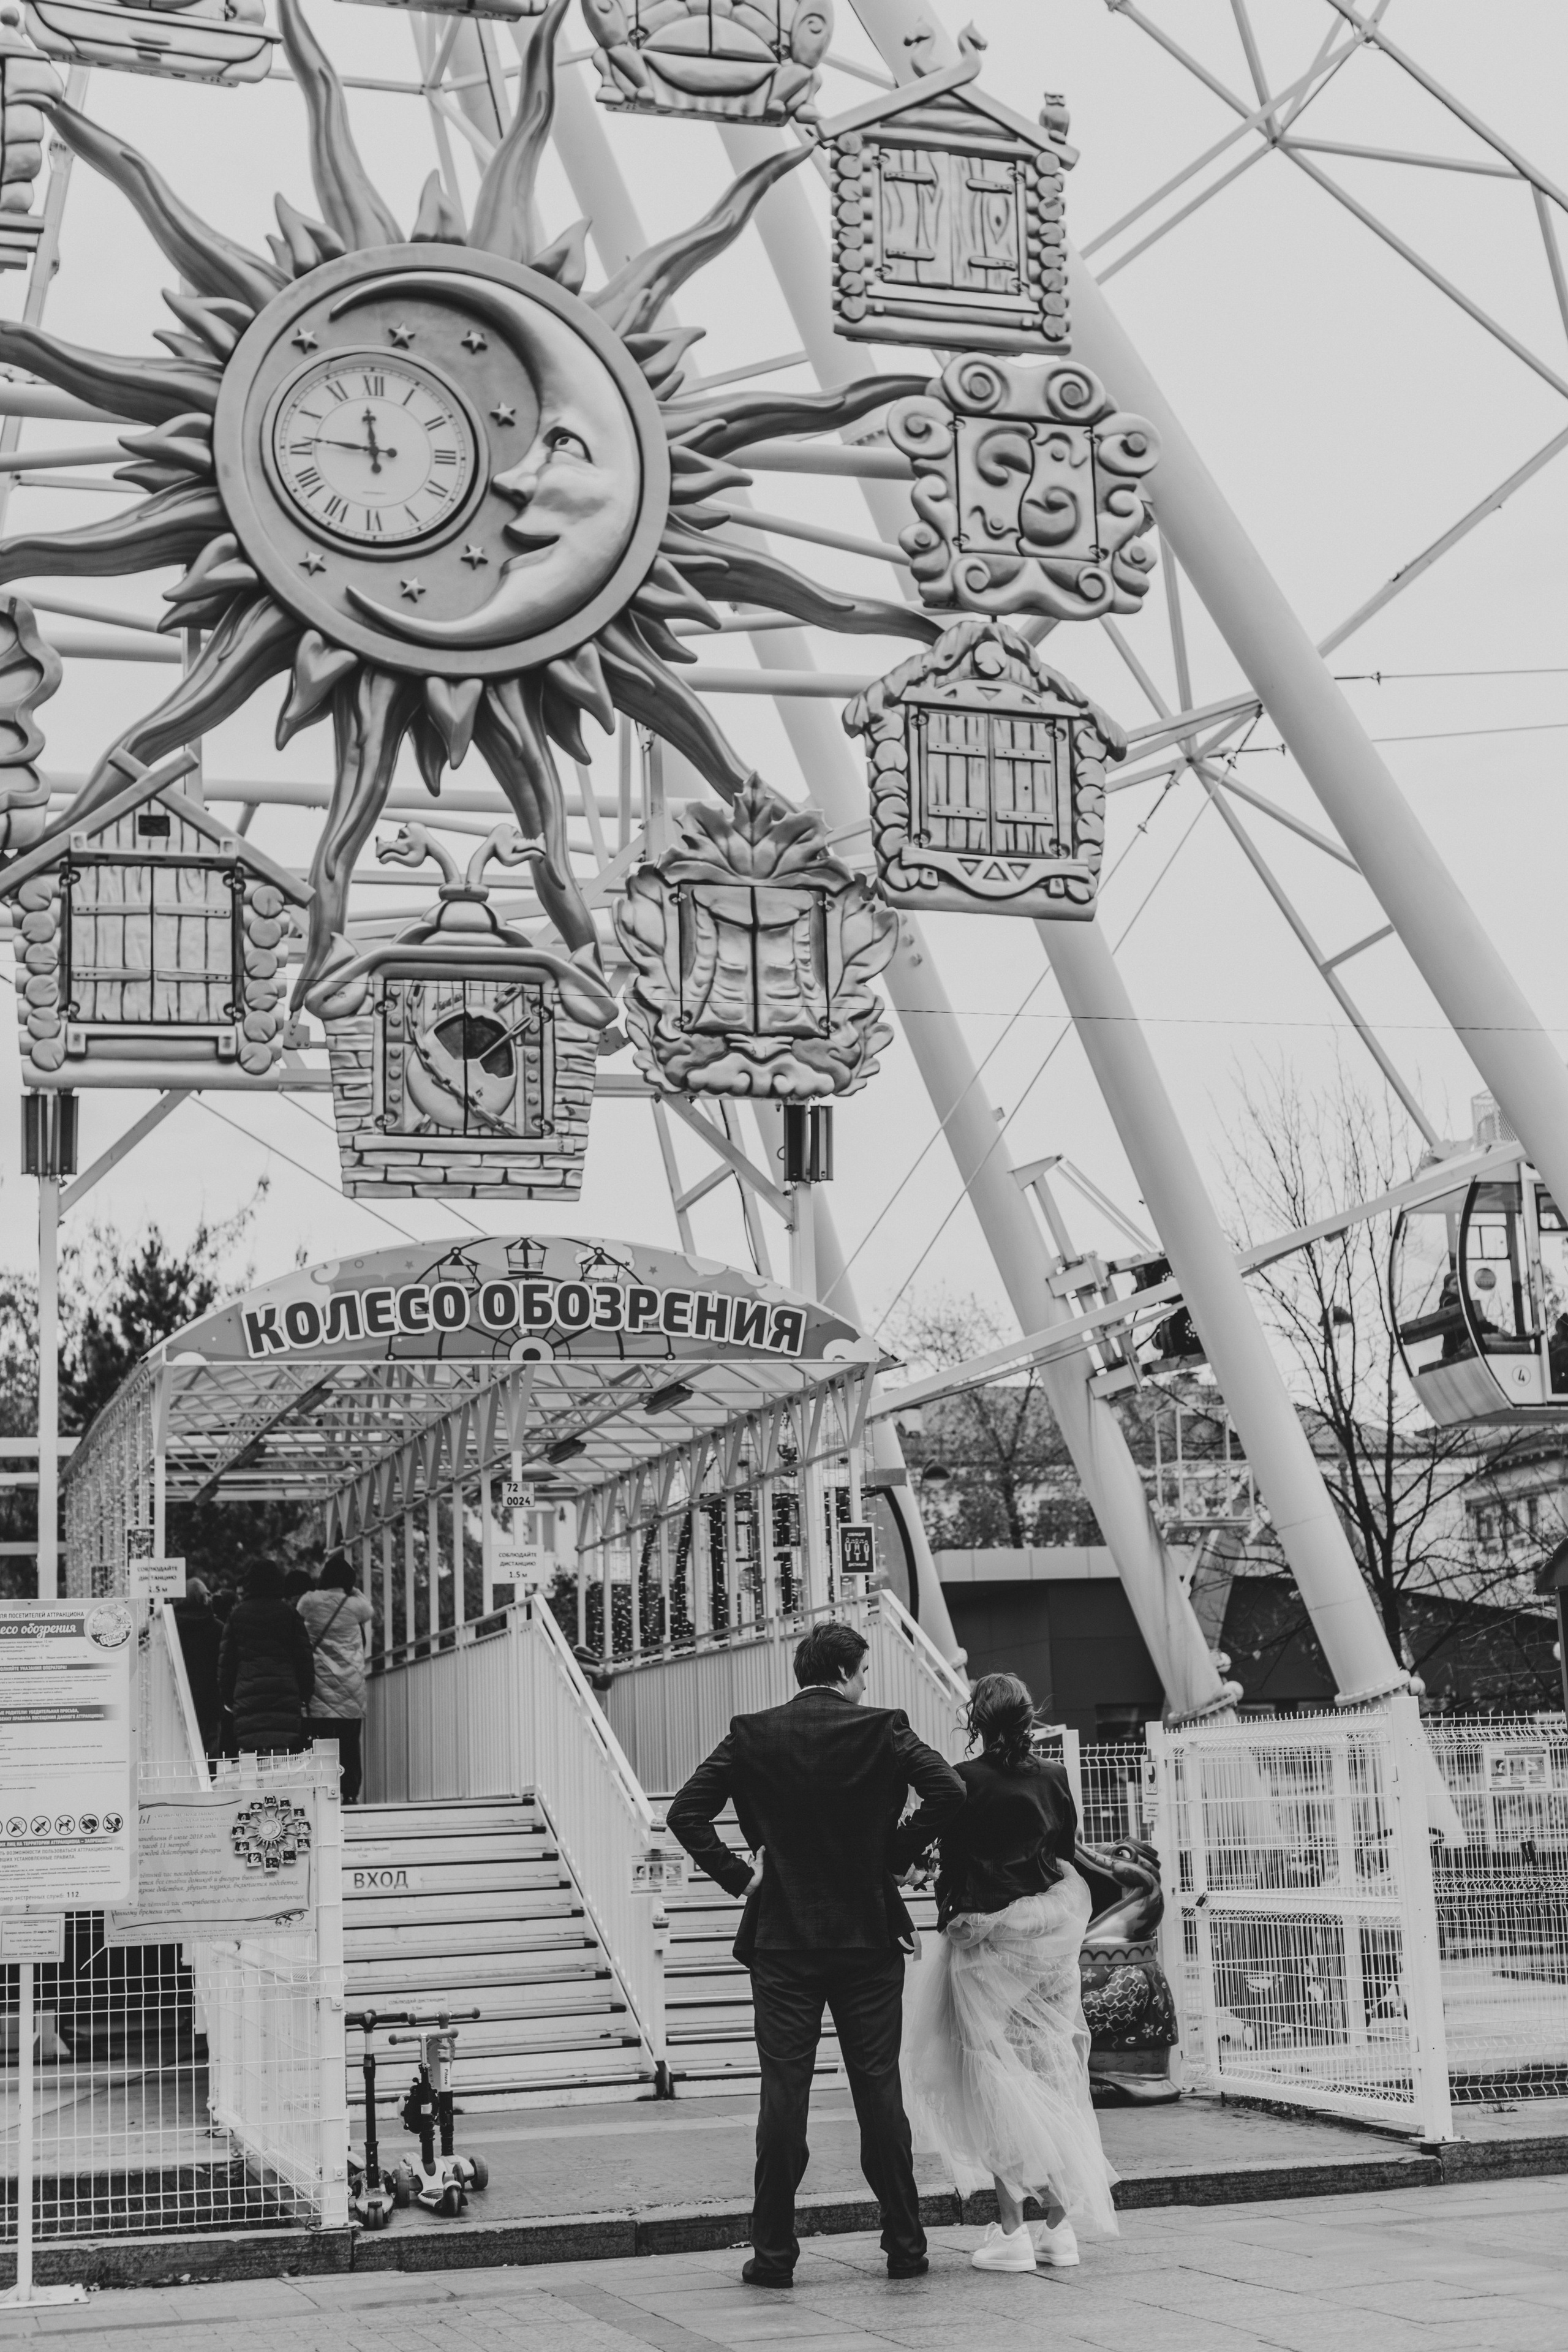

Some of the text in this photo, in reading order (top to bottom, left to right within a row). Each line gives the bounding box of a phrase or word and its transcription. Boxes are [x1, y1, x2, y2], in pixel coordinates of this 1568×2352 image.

[434, 449, 456, 466] III
[247, 1281, 804, 1355] КОЛЕСО ОБОЗРЕНИЯ
[1518, 1369, 1525, 1382] 4
[507, 1483, 518, 1492] 72
[507, 1496, 530, 1506] 0024
[0, 1623, 77, 1639] есо обозрения
[354, 1871, 409, 1889] ВХОД
